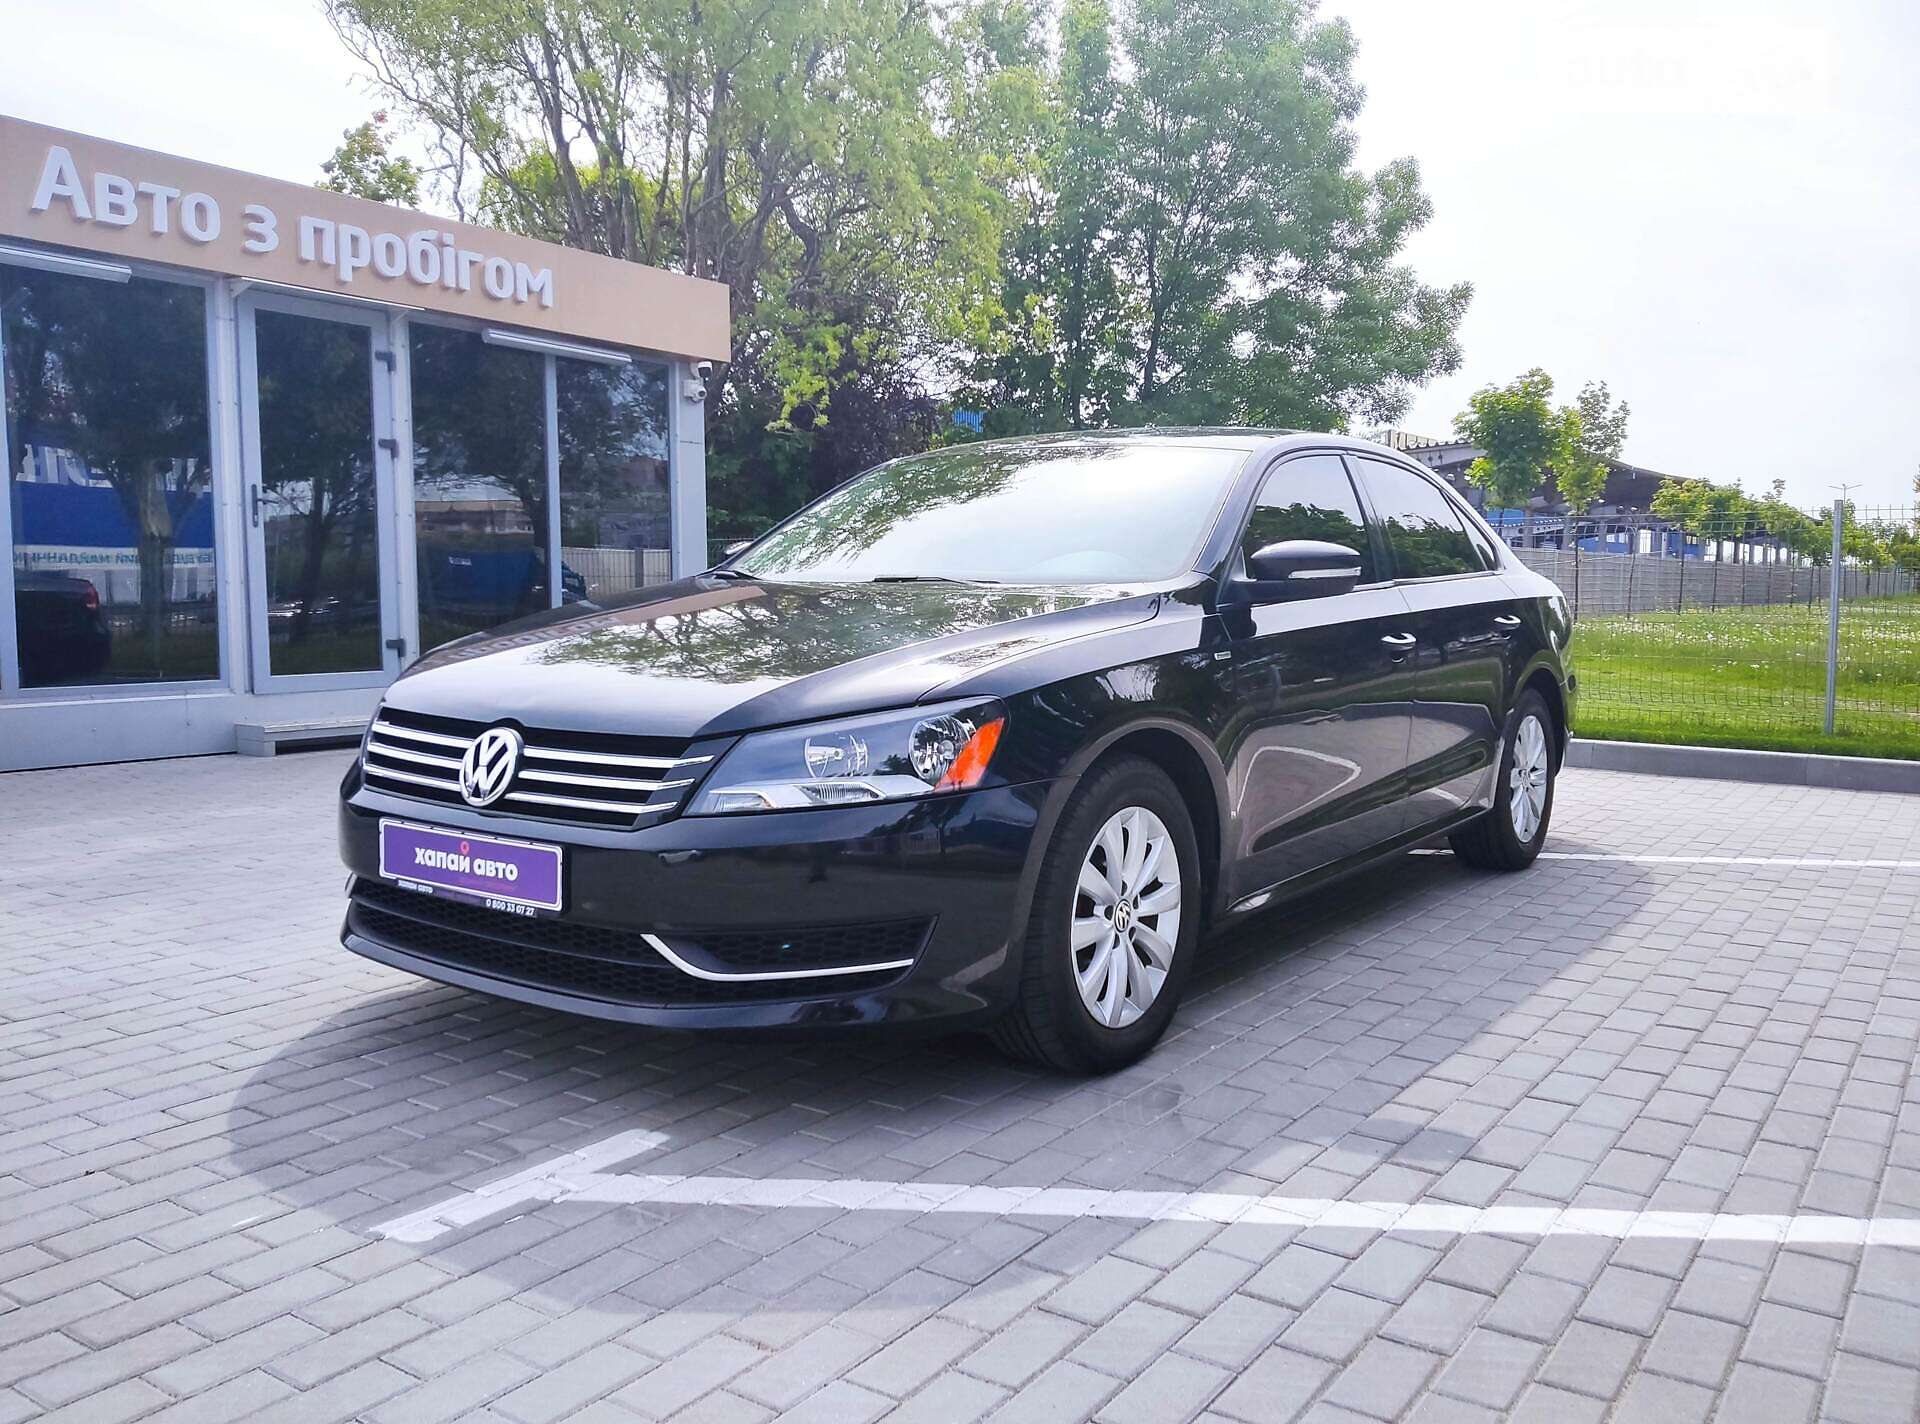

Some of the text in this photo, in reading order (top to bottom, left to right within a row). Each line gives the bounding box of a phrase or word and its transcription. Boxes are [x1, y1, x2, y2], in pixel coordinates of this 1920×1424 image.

[31, 145, 554, 309] Авто з пробігом
[473, 857, 518, 882] авто
[492, 900, 506, 911] 800
